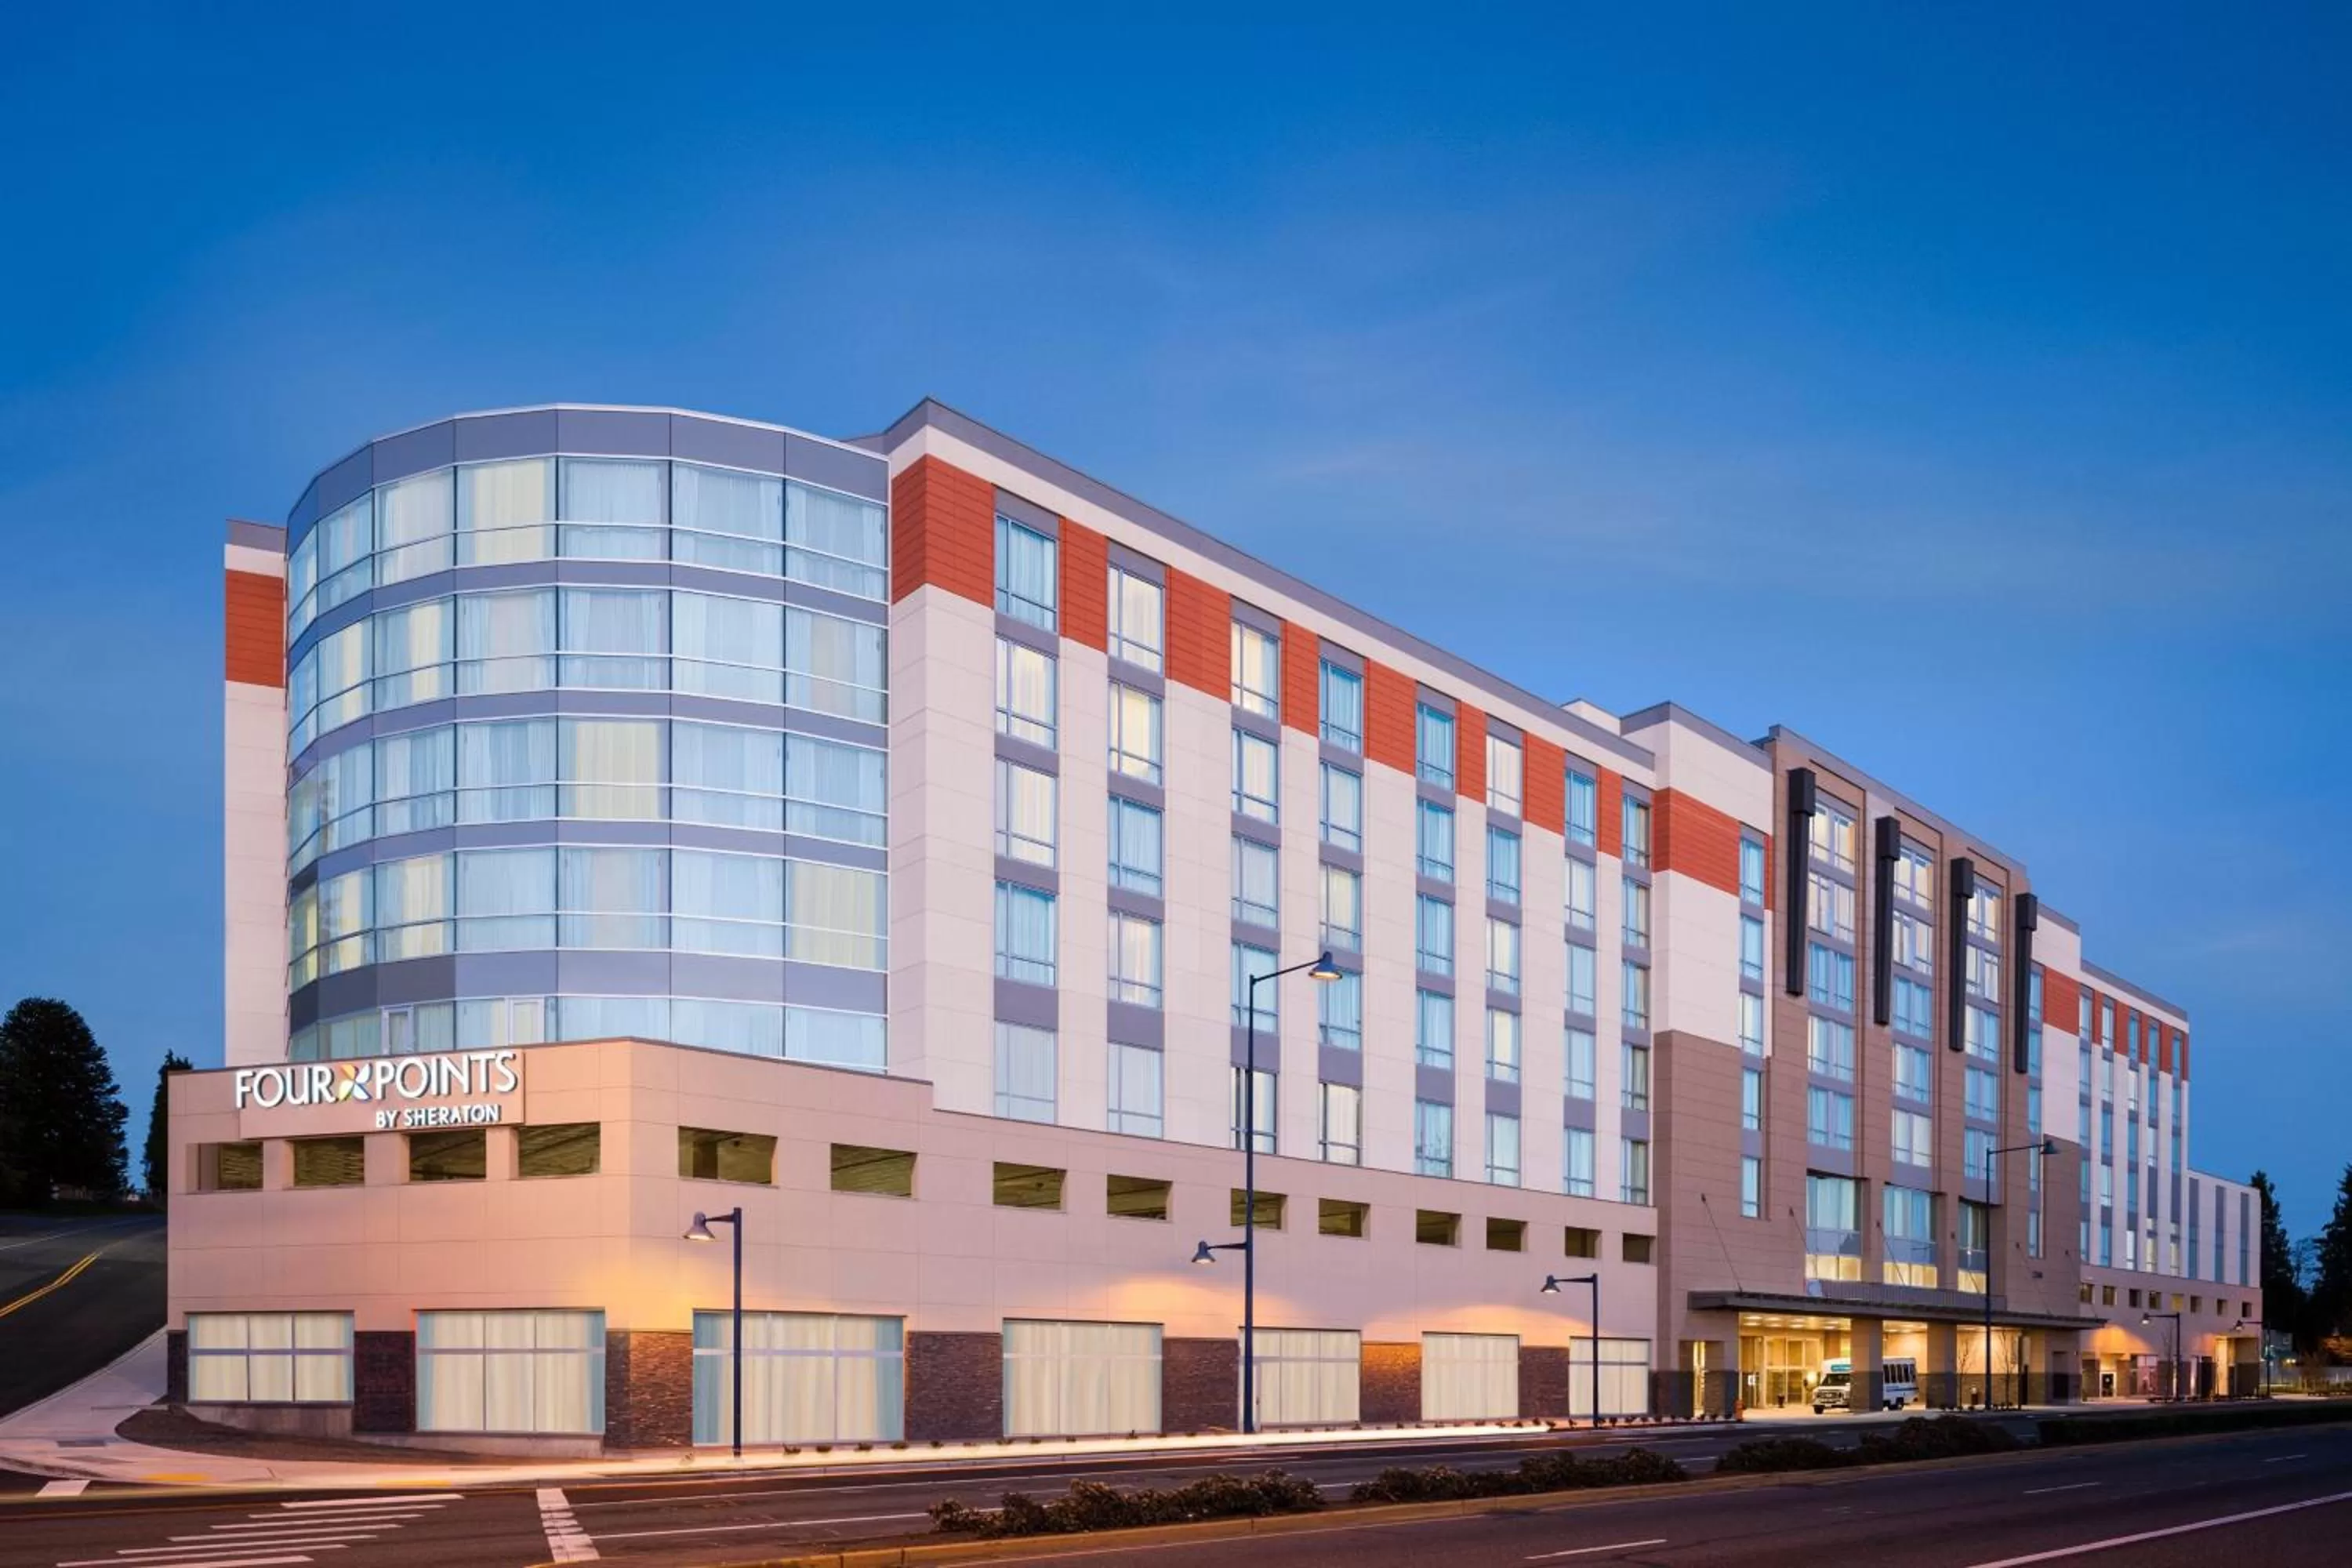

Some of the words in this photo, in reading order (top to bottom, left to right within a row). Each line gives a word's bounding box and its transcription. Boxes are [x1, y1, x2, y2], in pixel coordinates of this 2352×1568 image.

[235, 1065, 336, 1109] FOUR
[376, 1053, 517, 1099] POINTS
[376, 1106, 399, 1128] BY
[404, 1104, 501, 1127] SHERATON
